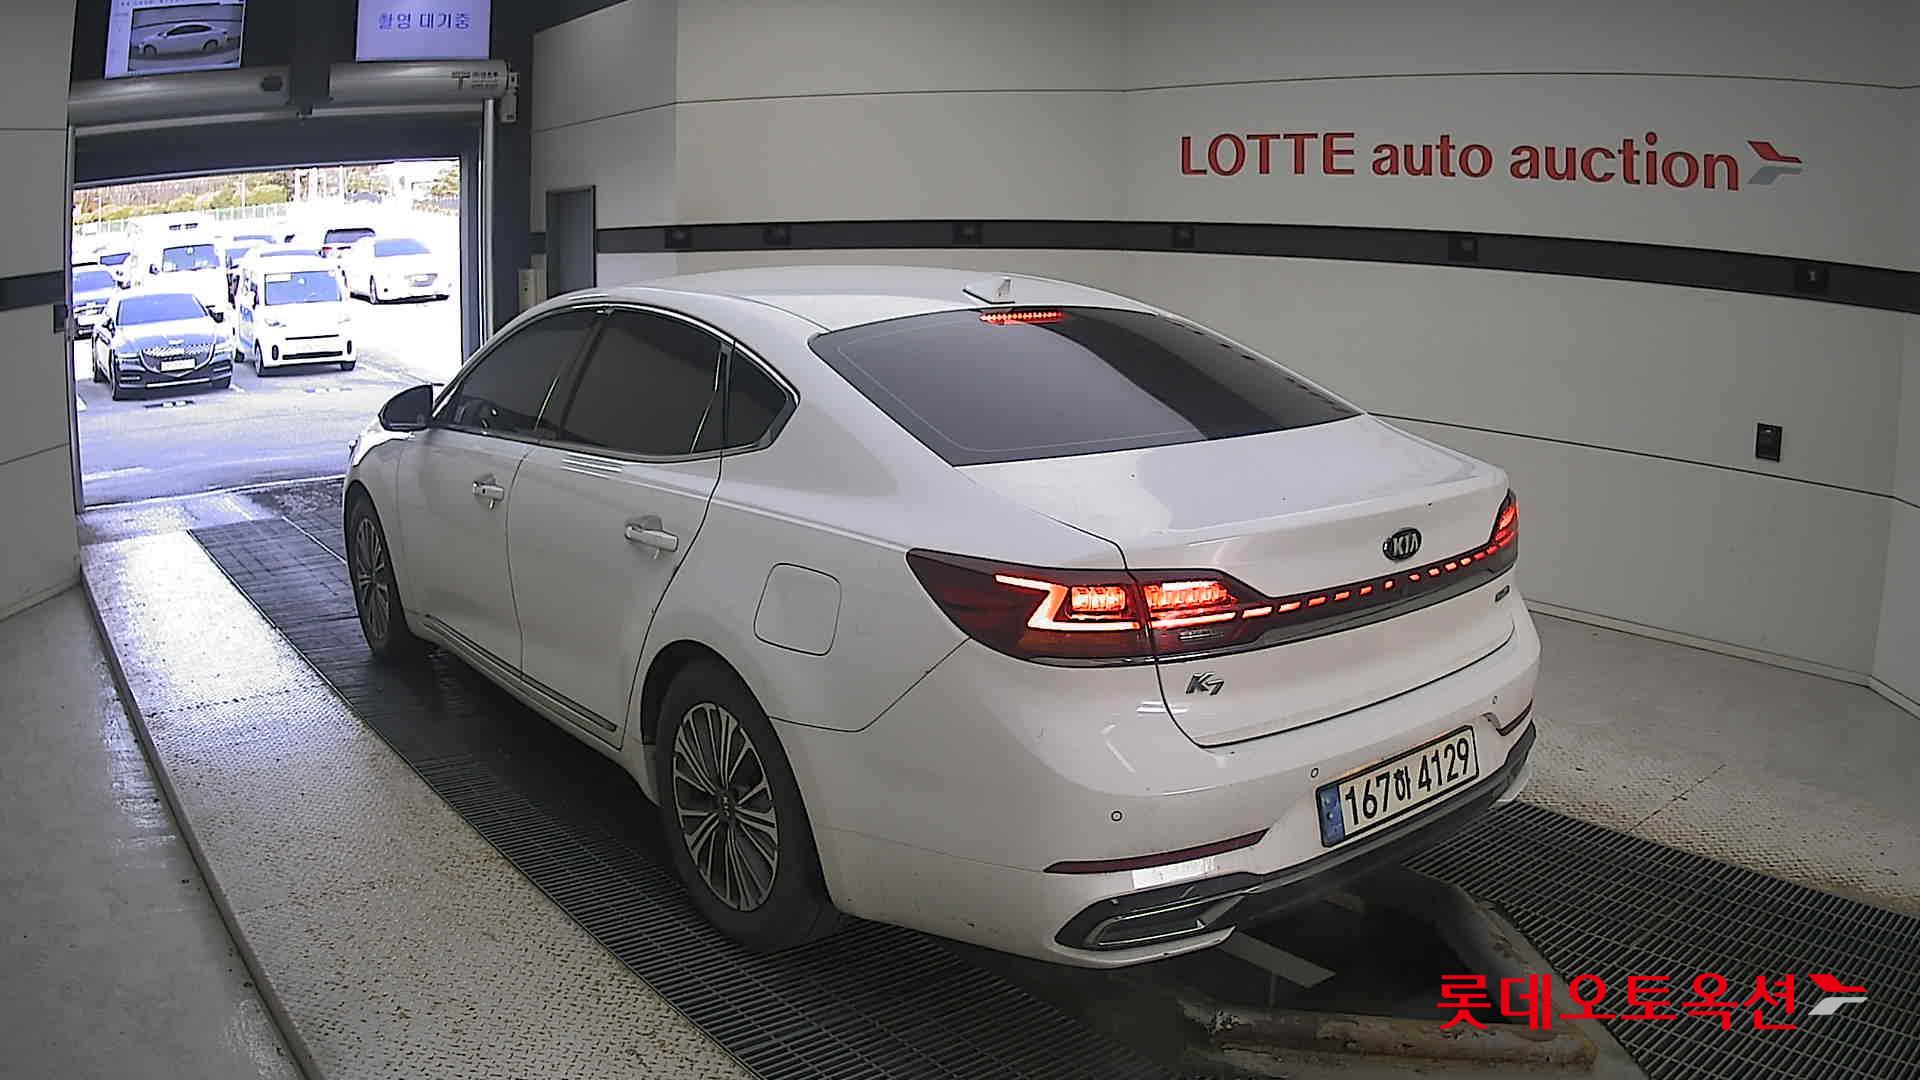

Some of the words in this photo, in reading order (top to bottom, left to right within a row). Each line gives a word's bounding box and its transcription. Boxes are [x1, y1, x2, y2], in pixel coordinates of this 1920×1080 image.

[419, 12, 470, 30] 대기중
[1181, 131, 1355, 177] LOTTE
[1372, 134, 1494, 178] auto
[1511, 132, 1741, 192] auction
[1392, 533, 1419, 557] KIA
[1185, 672, 1224, 696] K7
[1344, 765, 1412, 825] 167하
[1418, 737, 1470, 793] 4129
